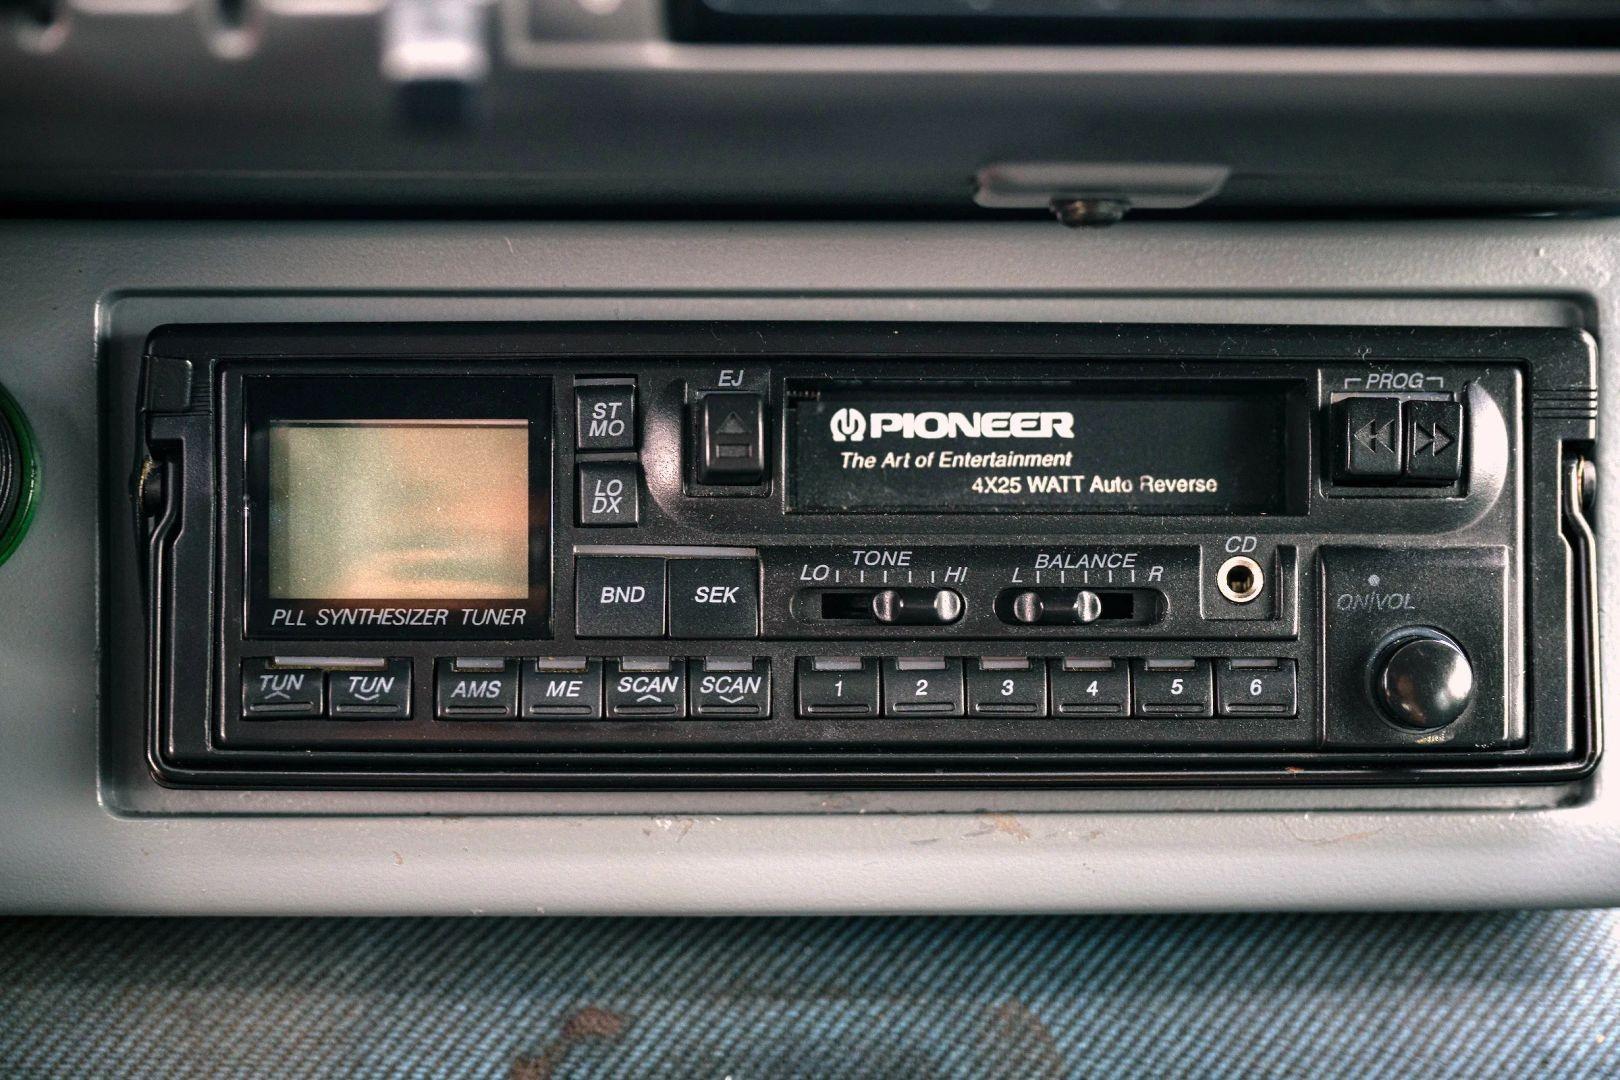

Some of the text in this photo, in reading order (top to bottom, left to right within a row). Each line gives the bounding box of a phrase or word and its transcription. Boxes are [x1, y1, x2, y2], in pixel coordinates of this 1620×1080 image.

[718, 370, 744, 387] EJ
[1365, 373, 1424, 389] PROG
[592, 403, 621, 419] ST
[589, 419, 625, 436] MO
[870, 411, 1074, 439] PIONEER
[841, 451, 1072, 469] The Art of Entertainment
[594, 480, 623, 496] LO
[972, 476, 1218, 493] 4X25 WATT Auto Reverse
[593, 497, 623, 513] DX
[1225, 536, 1257, 553] CD
[853, 551, 912, 567] TONE
[1035, 553, 1137, 569] BALANCE
[801, 565, 829, 581] LO
[945, 566, 968, 582] HI
[1012, 568, 1023, 583] L
[1148, 566, 1164, 582] R
[600, 587, 645, 603] BND
[695, 587, 738, 603] SEK
[271, 609, 525, 625] PLL SYNTHESIZER TUNER
[259, 675, 304, 691] TUN
[348, 677, 394, 694] TUN
[451, 681, 501, 698] AMS
[546, 681, 581, 698] ME
[617, 676, 678, 693] SCAN
[700, 677, 761, 694] SCAN
[834, 681, 843, 697] 1
[916, 680, 928, 696] 2
[1001, 680, 1014, 696] 3
[1086, 680, 1099, 696] 4
[1171, 679, 1184, 695] 5
[1250, 680, 1262, 696] 6
